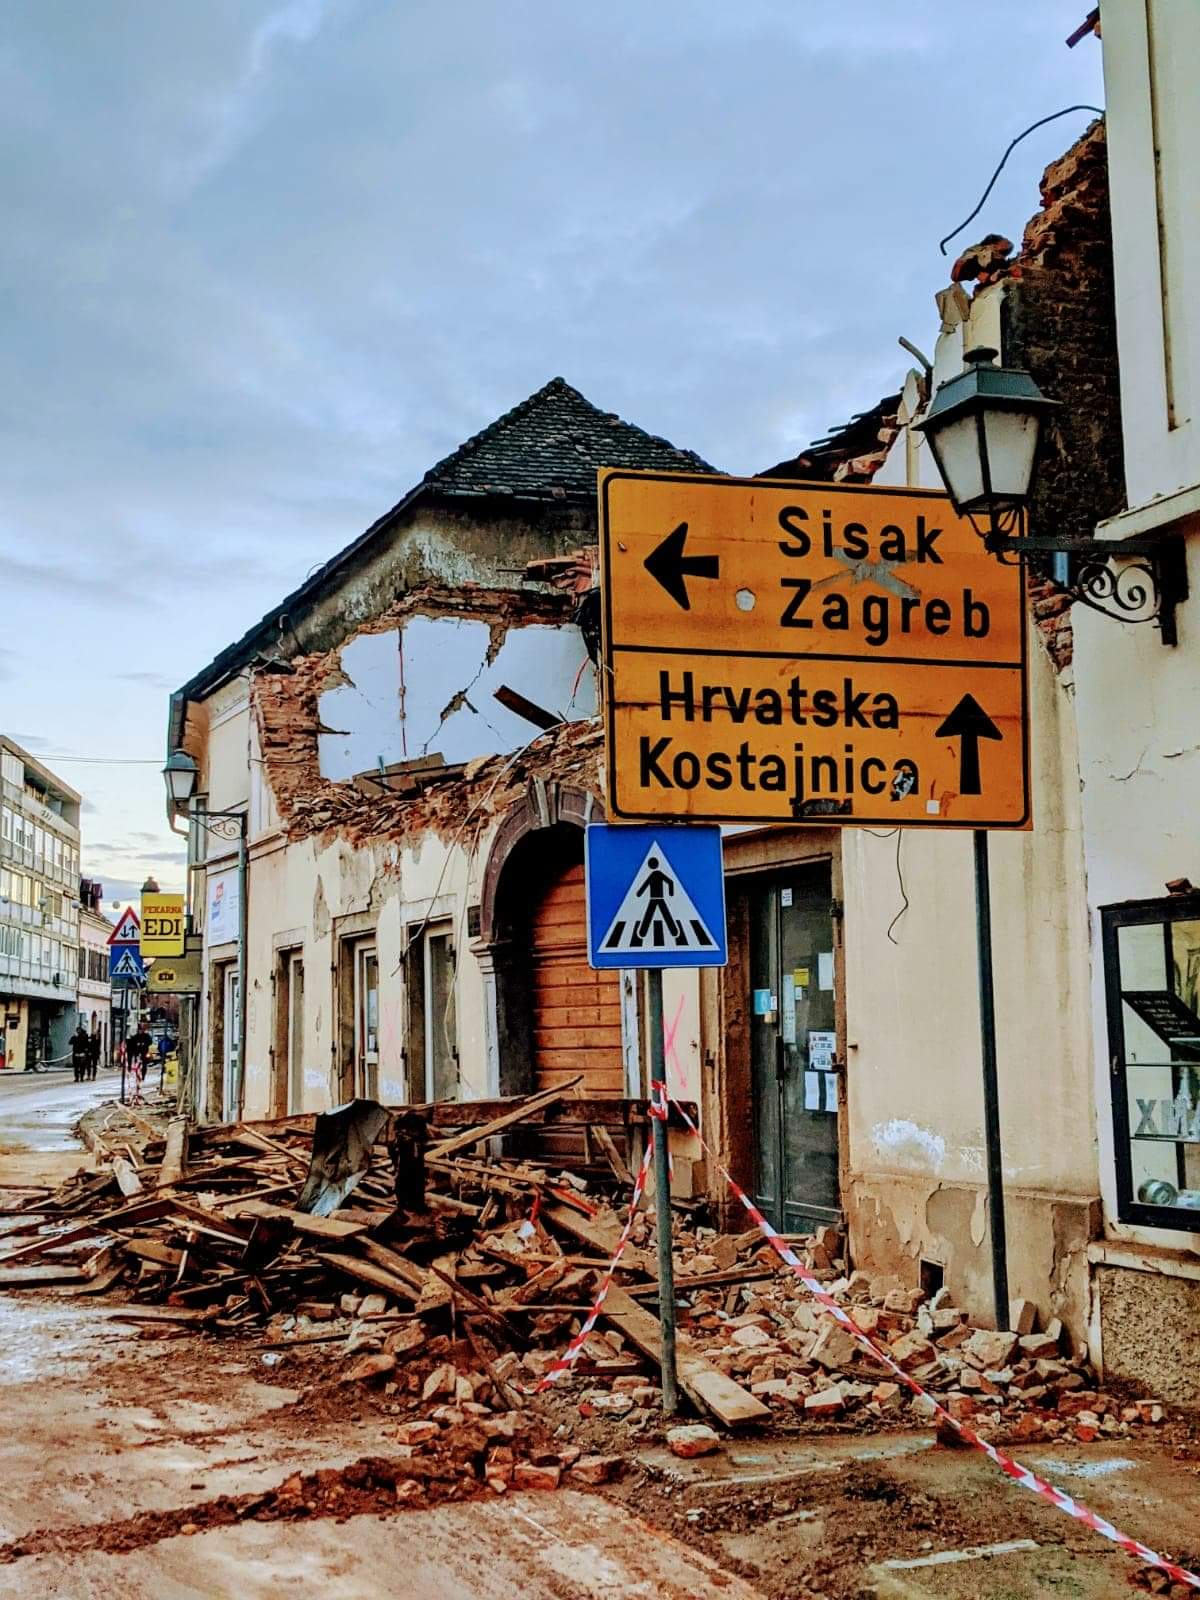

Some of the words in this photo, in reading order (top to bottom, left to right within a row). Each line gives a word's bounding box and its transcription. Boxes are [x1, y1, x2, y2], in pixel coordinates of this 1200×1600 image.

[778, 505, 943, 564] Sisak
[780, 577, 991, 646] Zagreb
[659, 670, 900, 730] Hrvatska
[639, 736, 919, 808] Kostajnica
[143, 918, 181, 936] EDI
